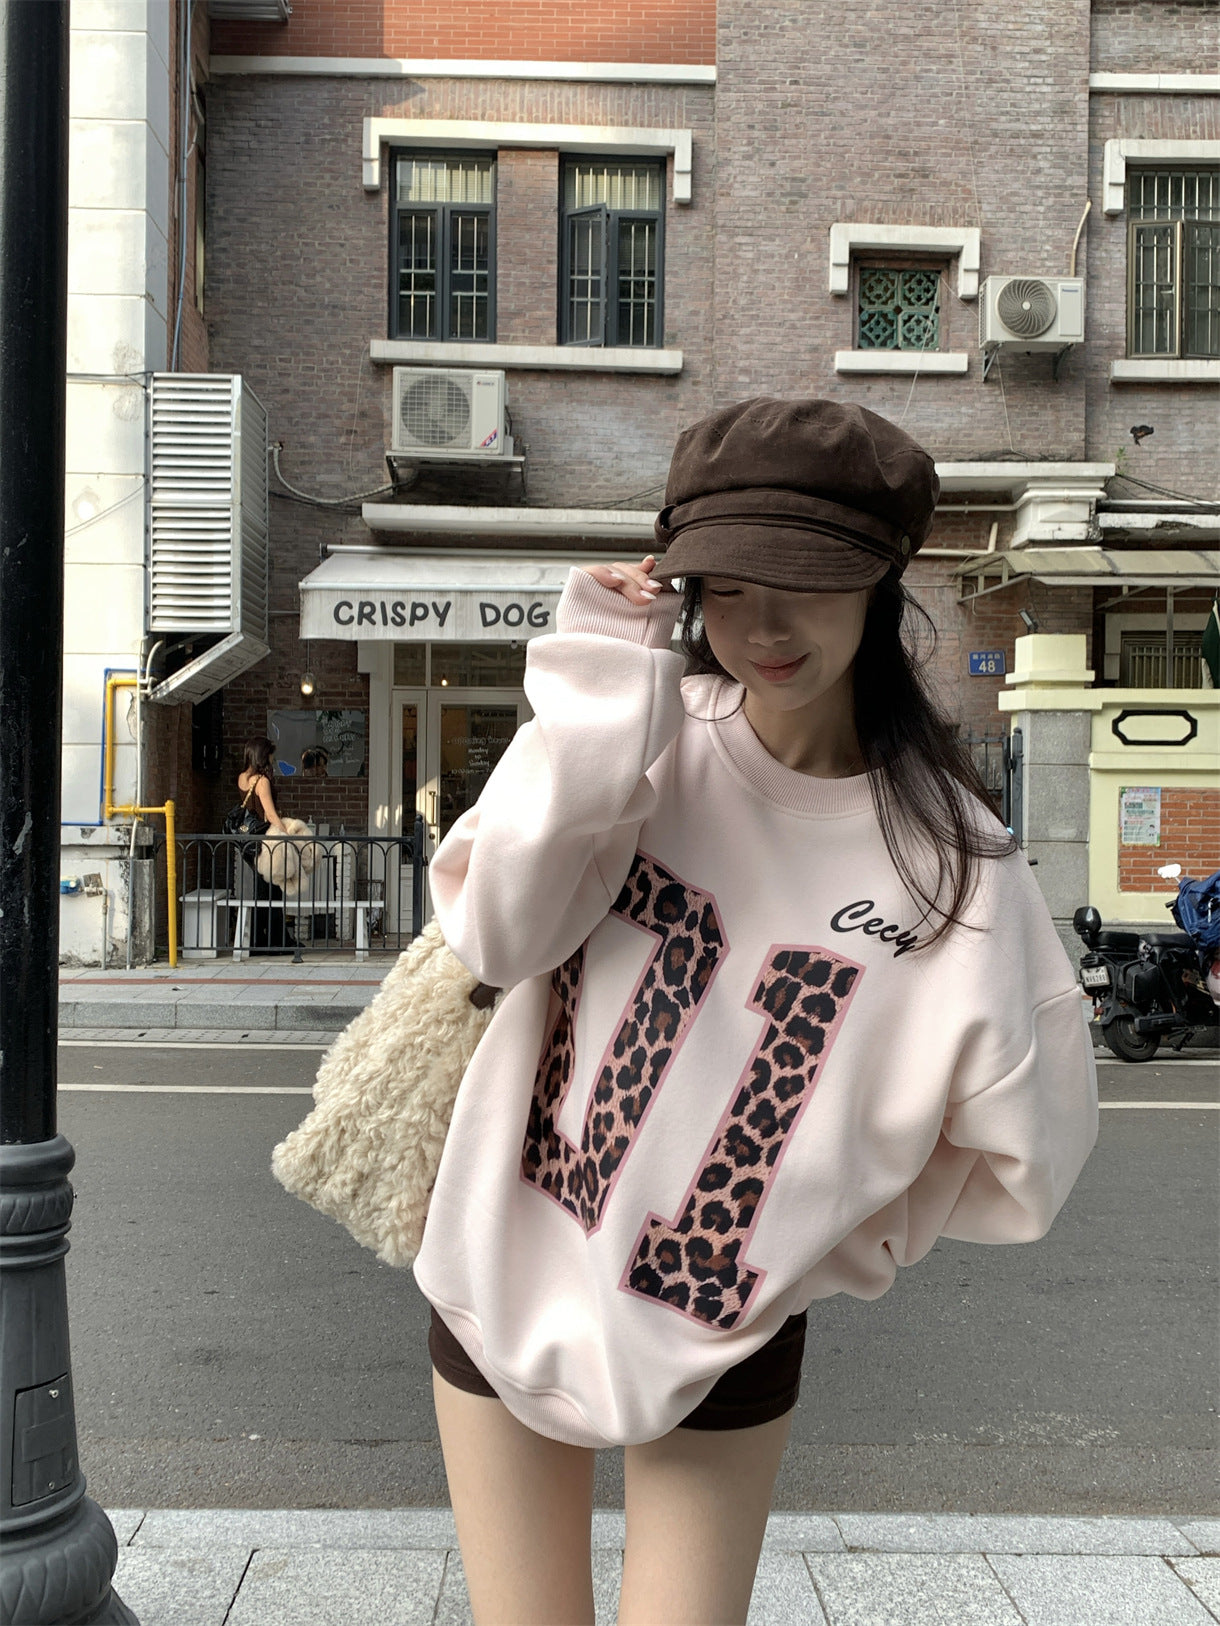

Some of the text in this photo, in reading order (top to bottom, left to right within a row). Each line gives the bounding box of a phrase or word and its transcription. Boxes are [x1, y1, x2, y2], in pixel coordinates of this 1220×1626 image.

[333, 600, 550, 628] CRISPY DOG
[978, 660, 996, 673] 48
[830, 899, 918, 958] Cecy
